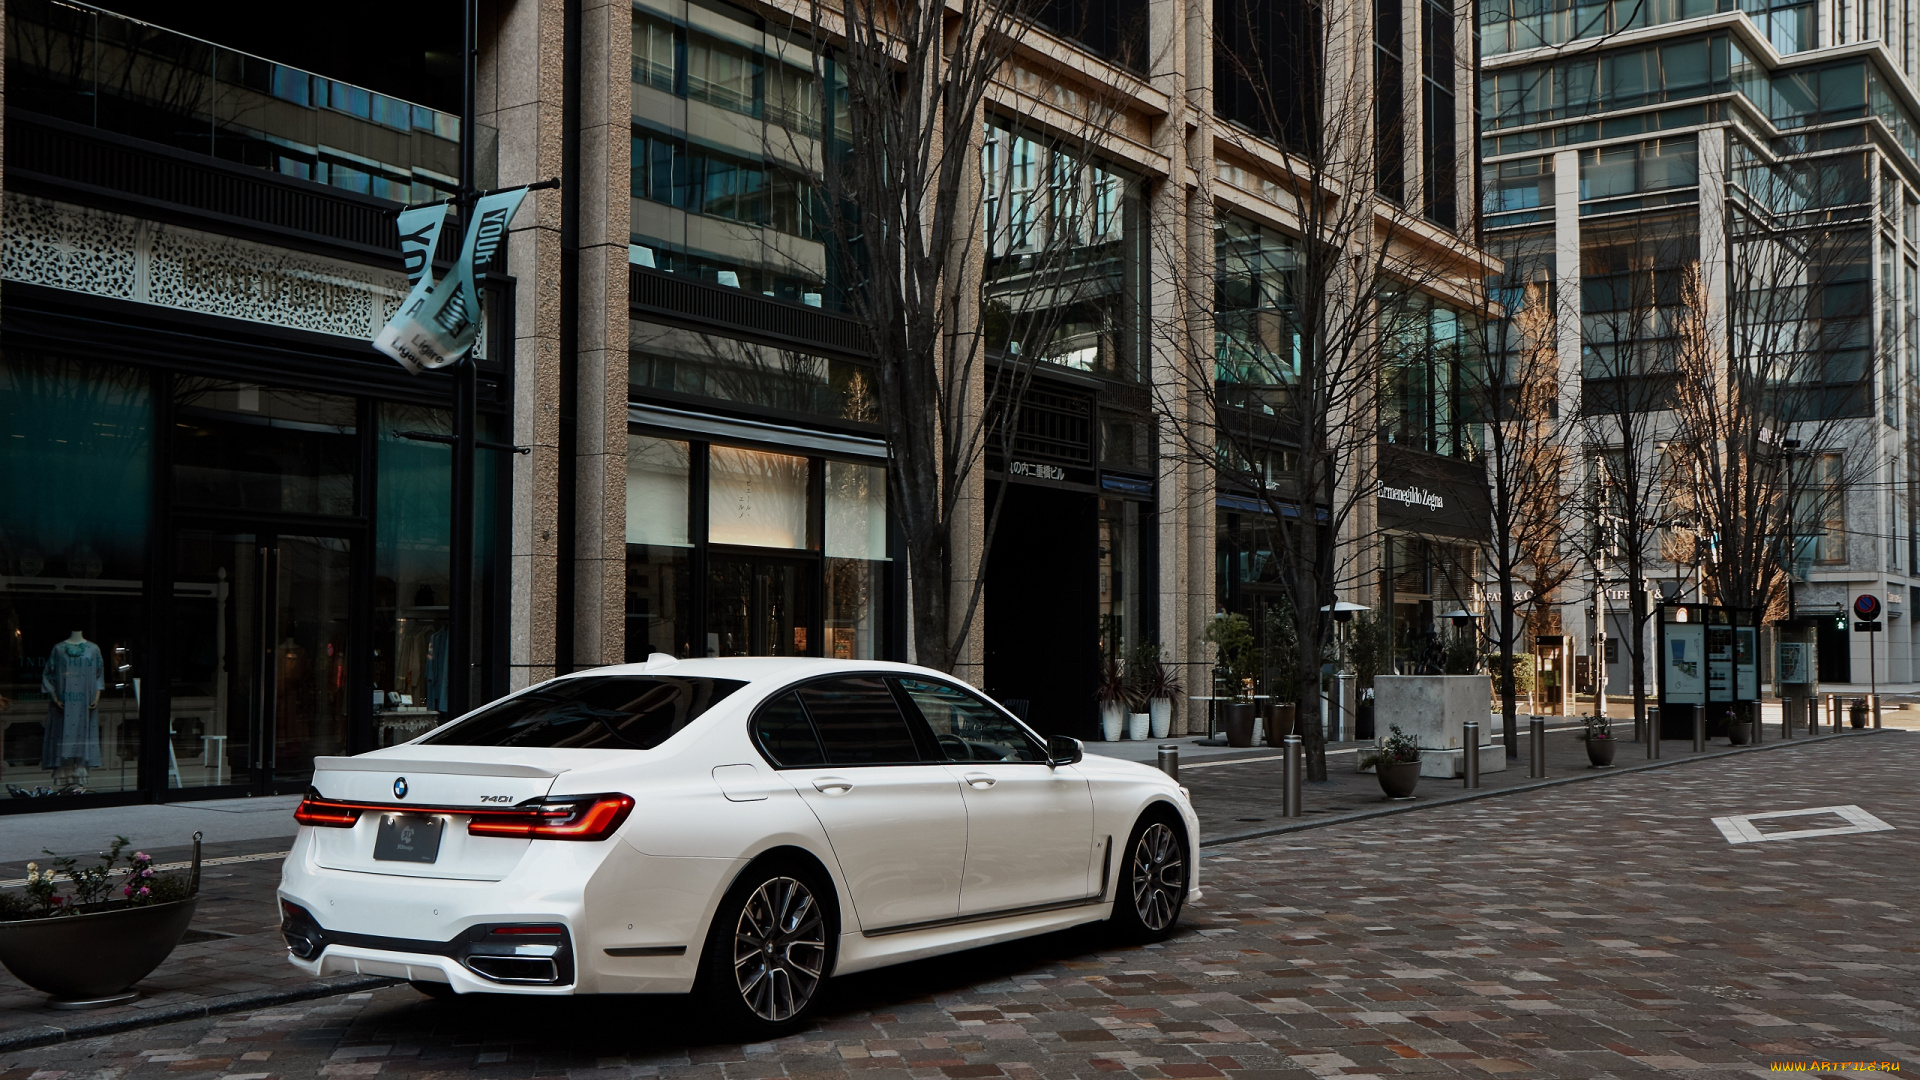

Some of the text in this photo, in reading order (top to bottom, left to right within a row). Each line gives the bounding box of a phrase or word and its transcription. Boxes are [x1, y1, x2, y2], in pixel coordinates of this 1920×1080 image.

[1009, 461, 1065, 481] の内二重橋ビル
[1377, 480, 1444, 512] Ermenegildo Zegna
[1513, 591, 1523, 601] &
[1654, 588, 1664, 599] &
